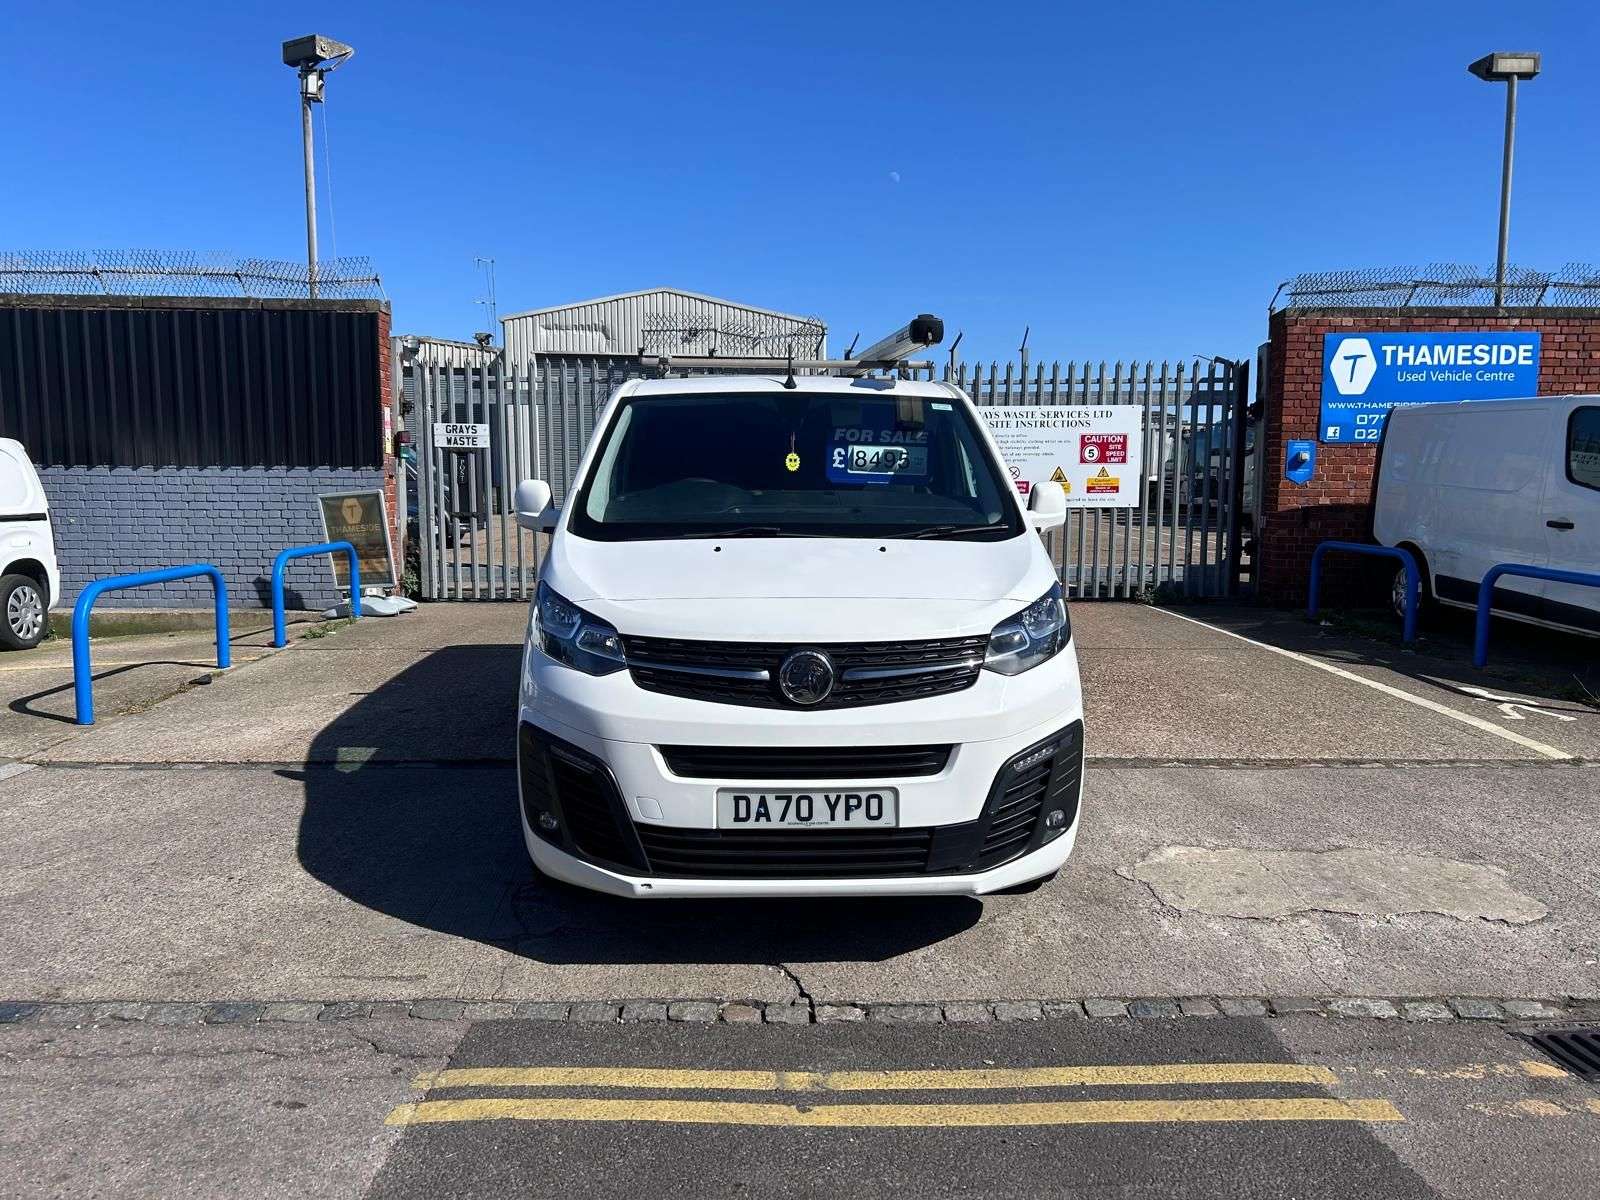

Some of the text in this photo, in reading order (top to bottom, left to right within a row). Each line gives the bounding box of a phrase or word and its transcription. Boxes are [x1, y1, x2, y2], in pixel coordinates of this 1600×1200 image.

[1381, 344, 1534, 366] THAMESIDE
[1397, 370, 1516, 382] Used Vehicle Centre
[1003, 411, 1037, 419] WASTE
[1040, 410, 1090, 419] SERVICES
[1093, 410, 1113, 418] LTD
[445, 424, 478, 435] GRAYS
[989, 420, 1092, 428] SITE INSTRUCTIONS
[833, 428, 929, 443] FOR SALE
[1084, 435, 1124, 443] CAUTION
[1354, 429, 1382, 440] 02
[446, 436, 478, 446] WASTE
[1088, 449, 1095, 458] 5
[732, 793, 884, 823] DA70 YPO
